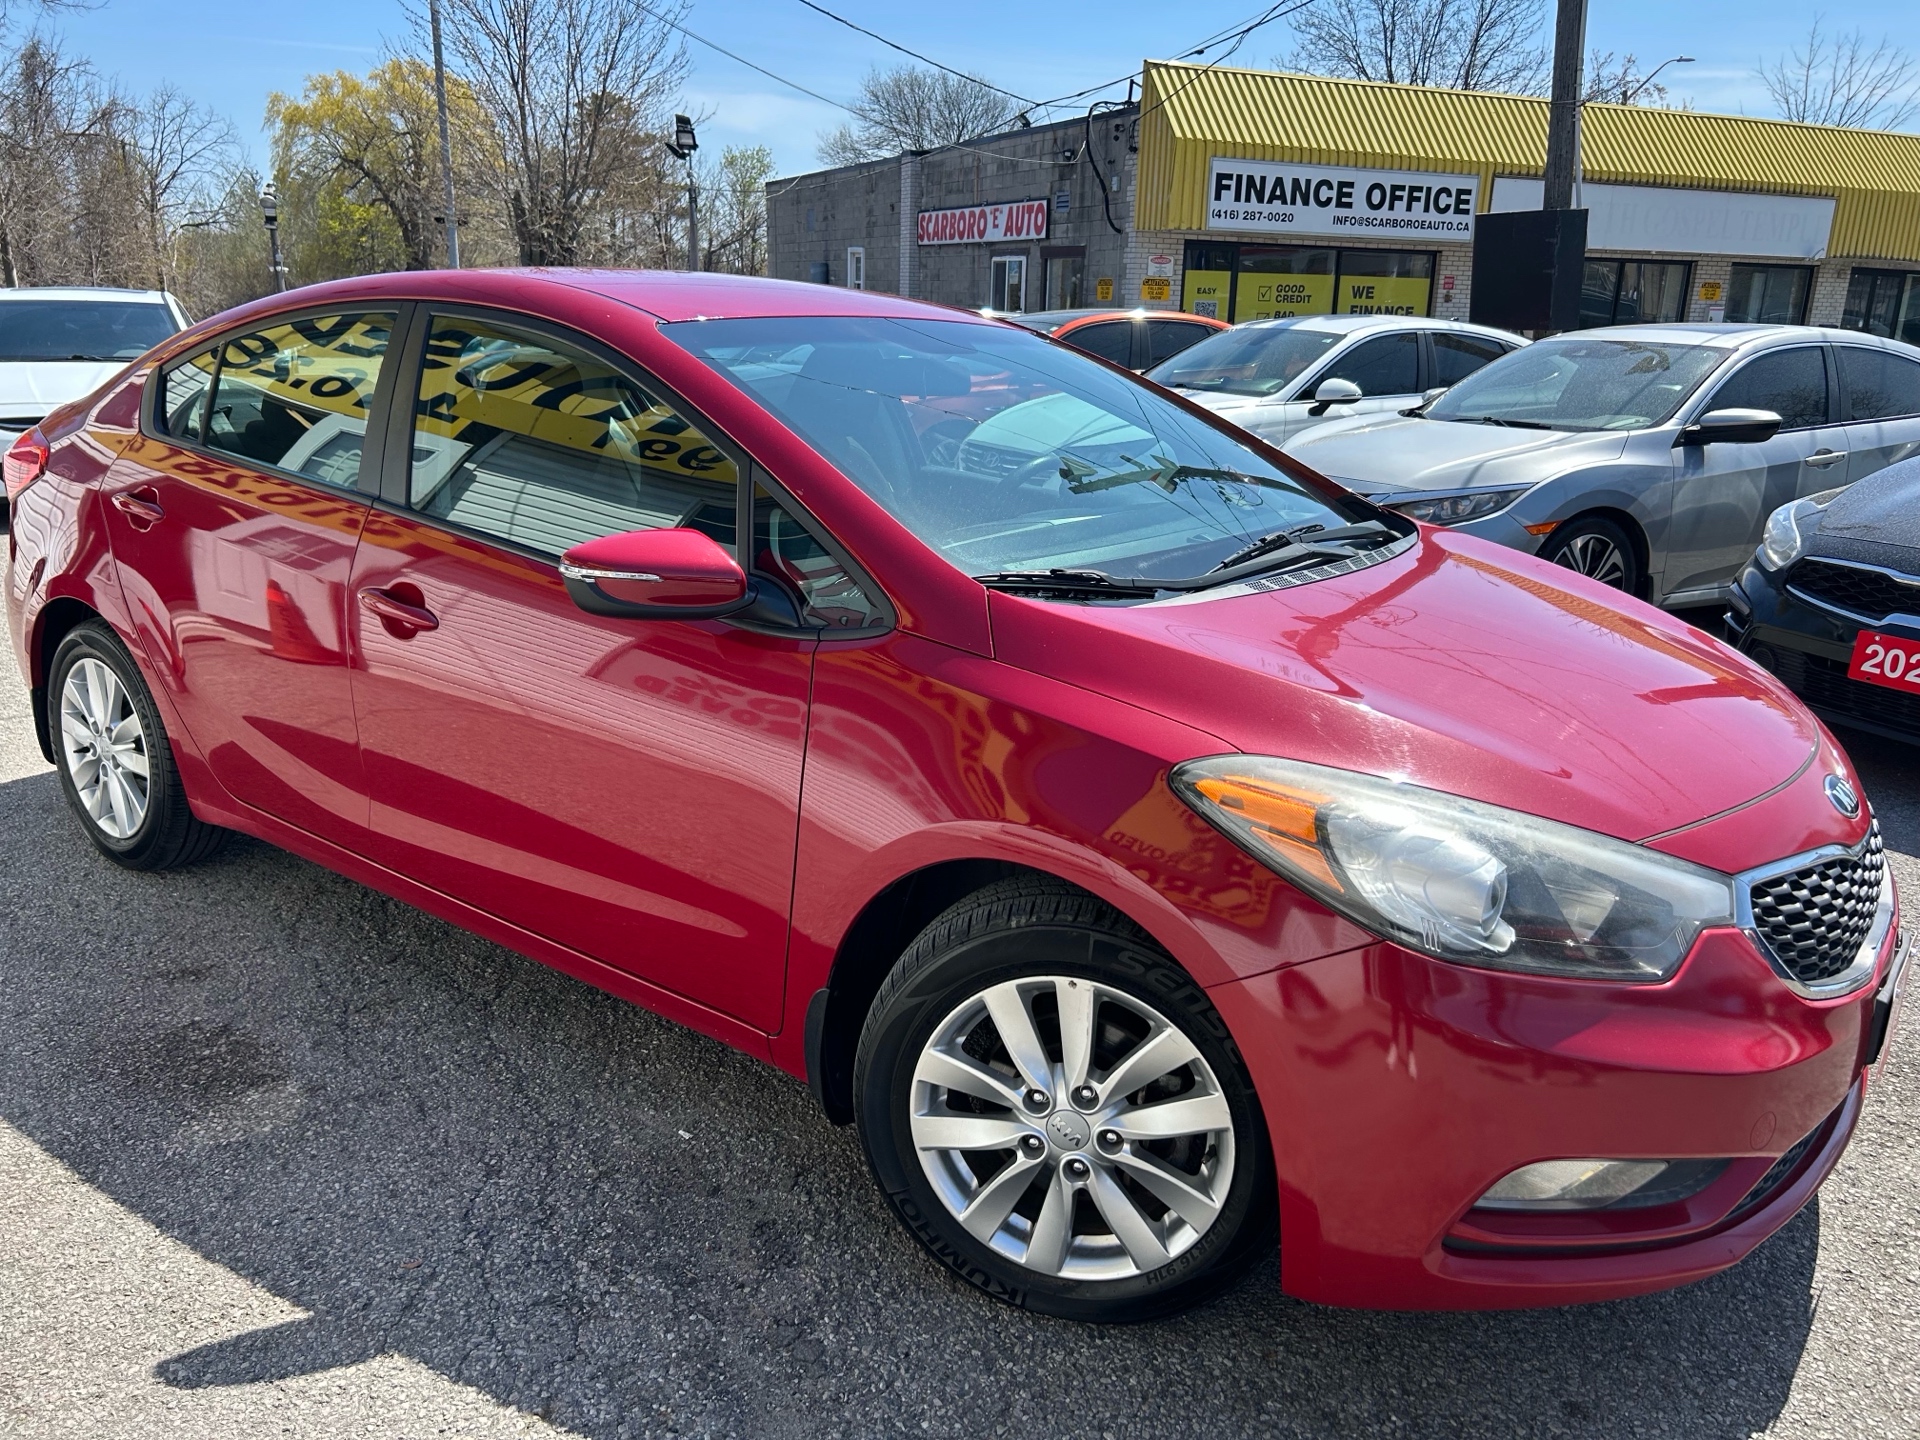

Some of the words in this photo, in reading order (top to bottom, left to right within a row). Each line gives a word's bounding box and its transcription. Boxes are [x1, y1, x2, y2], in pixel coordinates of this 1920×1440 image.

[1214, 172, 1355, 209] FINANCE
[1366, 182, 1472, 215] OFFICE
[918, 208, 988, 243] SCARBORO
[1003, 202, 1046, 238] AUTO
[1212, 208, 1239, 220] (416)
[1242, 210, 1294, 223] 287-0020
[1332, 215, 1470, 232] INFO@SCARBOROEAUTO.CA
[1196, 287, 1217, 295] EASY
[1275, 284, 1305, 293] GOOD
[1351, 285, 1375, 300] WE
[1275, 294, 1312, 304] CREDIT
[1273, 310, 1295, 319] BAD
[1349, 304, 1414, 316] FINANCE
[1050, 1115, 1082, 1148] KIA
[898, 1197, 1018, 1302] KUMHO
